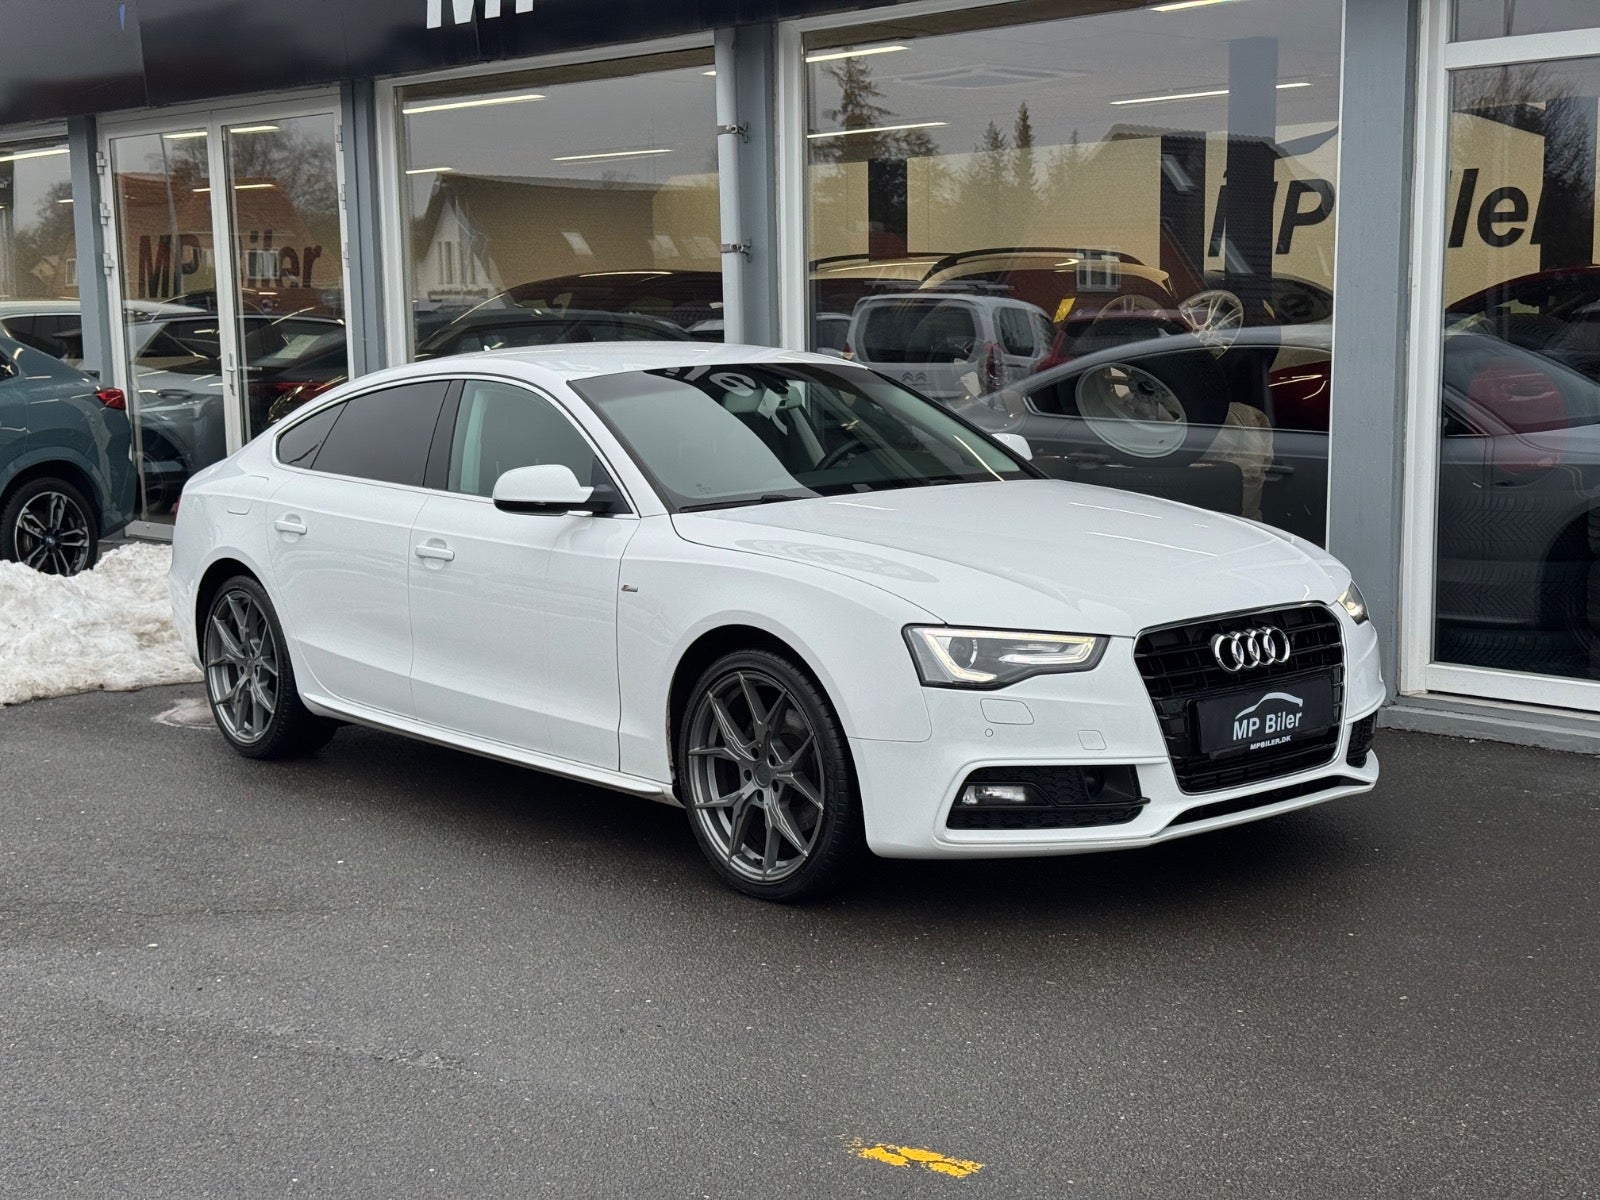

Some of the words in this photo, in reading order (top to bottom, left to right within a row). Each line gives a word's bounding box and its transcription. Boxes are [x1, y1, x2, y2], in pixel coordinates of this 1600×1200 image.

[138, 234, 200, 298] MP
[239, 229, 323, 289] iler
[1233, 718, 1260, 740] MP
[1265, 711, 1302, 733] Biler
[1250, 735, 1291, 750] MPBILER.DK
